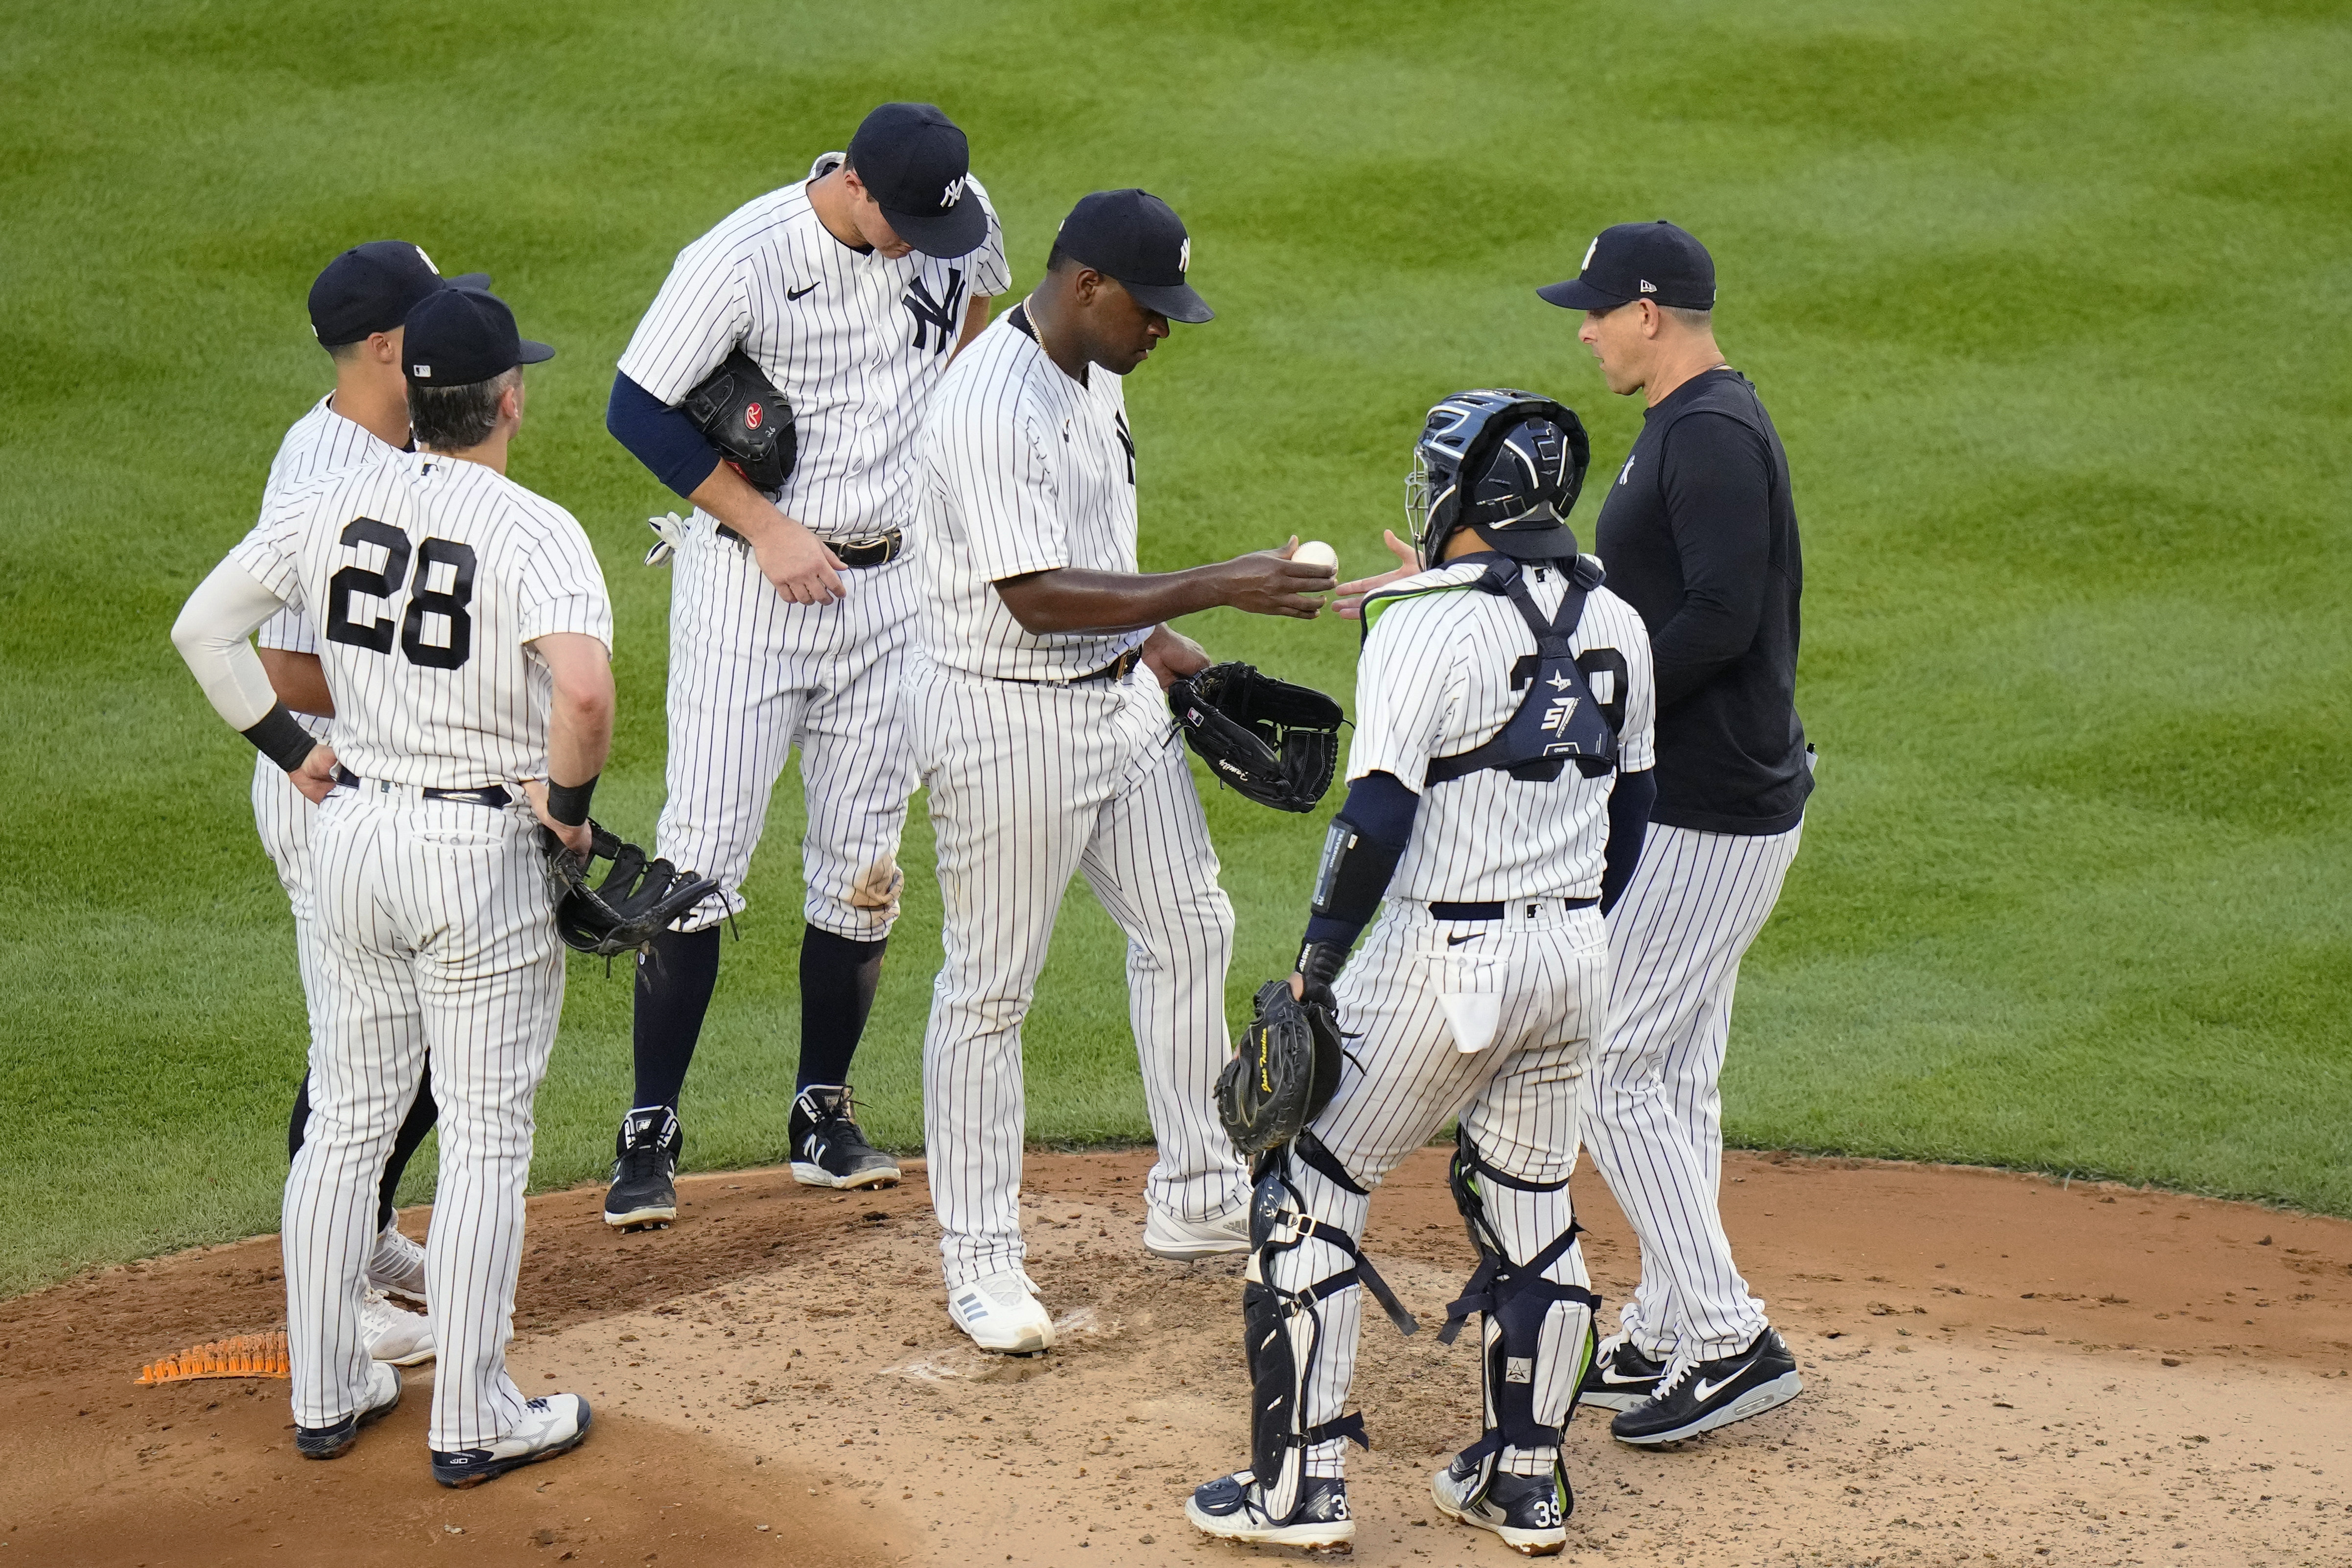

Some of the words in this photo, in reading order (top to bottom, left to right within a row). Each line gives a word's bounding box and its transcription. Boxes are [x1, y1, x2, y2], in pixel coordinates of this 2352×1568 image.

[902, 268, 966, 355] NY
[765, 426, 776, 438] 26
[326, 516, 477, 671] 28
[1262, 1068, 1272, 1093] Jose
[1331, 1494, 1352, 1520] 3
[1533, 1500, 1562, 1527] 39
